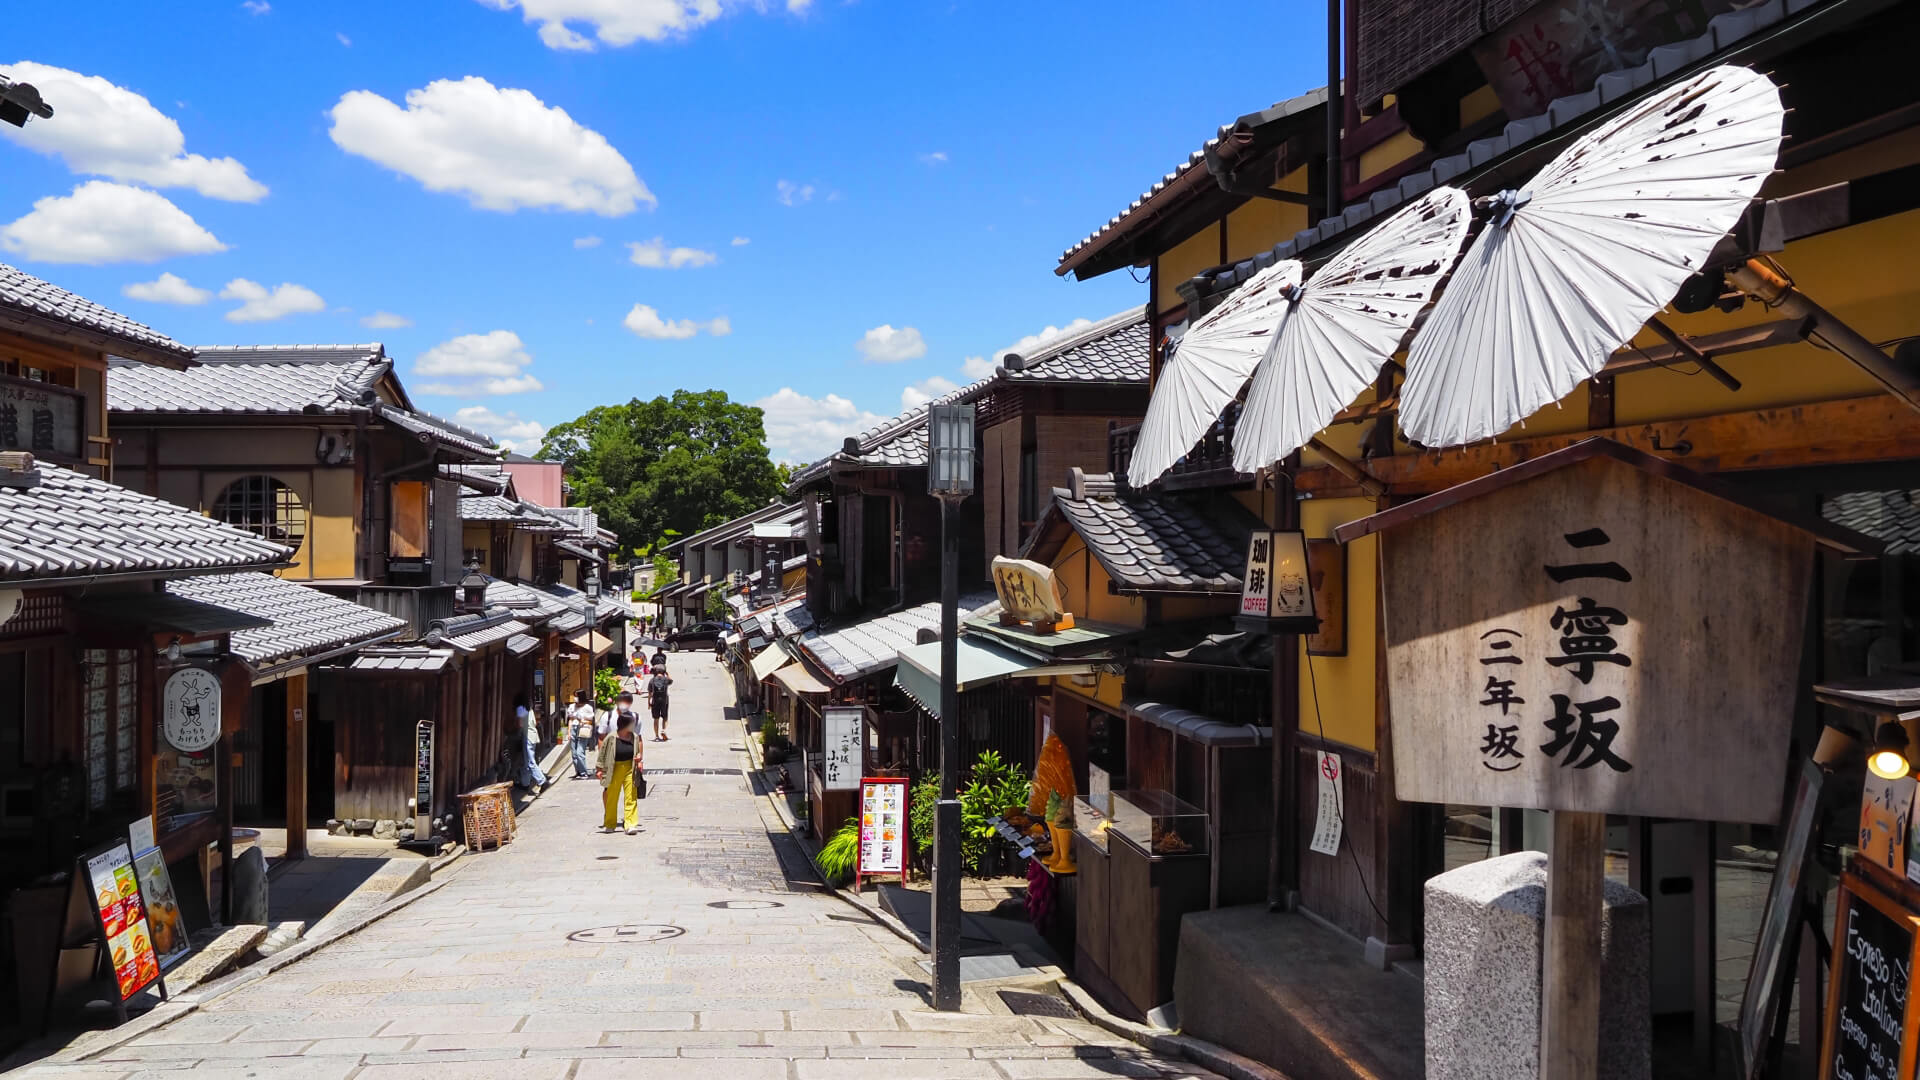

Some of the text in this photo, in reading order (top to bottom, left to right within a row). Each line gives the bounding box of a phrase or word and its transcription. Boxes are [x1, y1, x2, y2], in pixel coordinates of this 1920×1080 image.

[1248, 538, 1268, 594] 珈琲
[1243, 598, 1267, 611] COFFEE
[1539, 527, 1633, 773] 二寧坂
[827, 750, 840, 782] ふたば
[1847, 908, 1889, 983] Espresso
